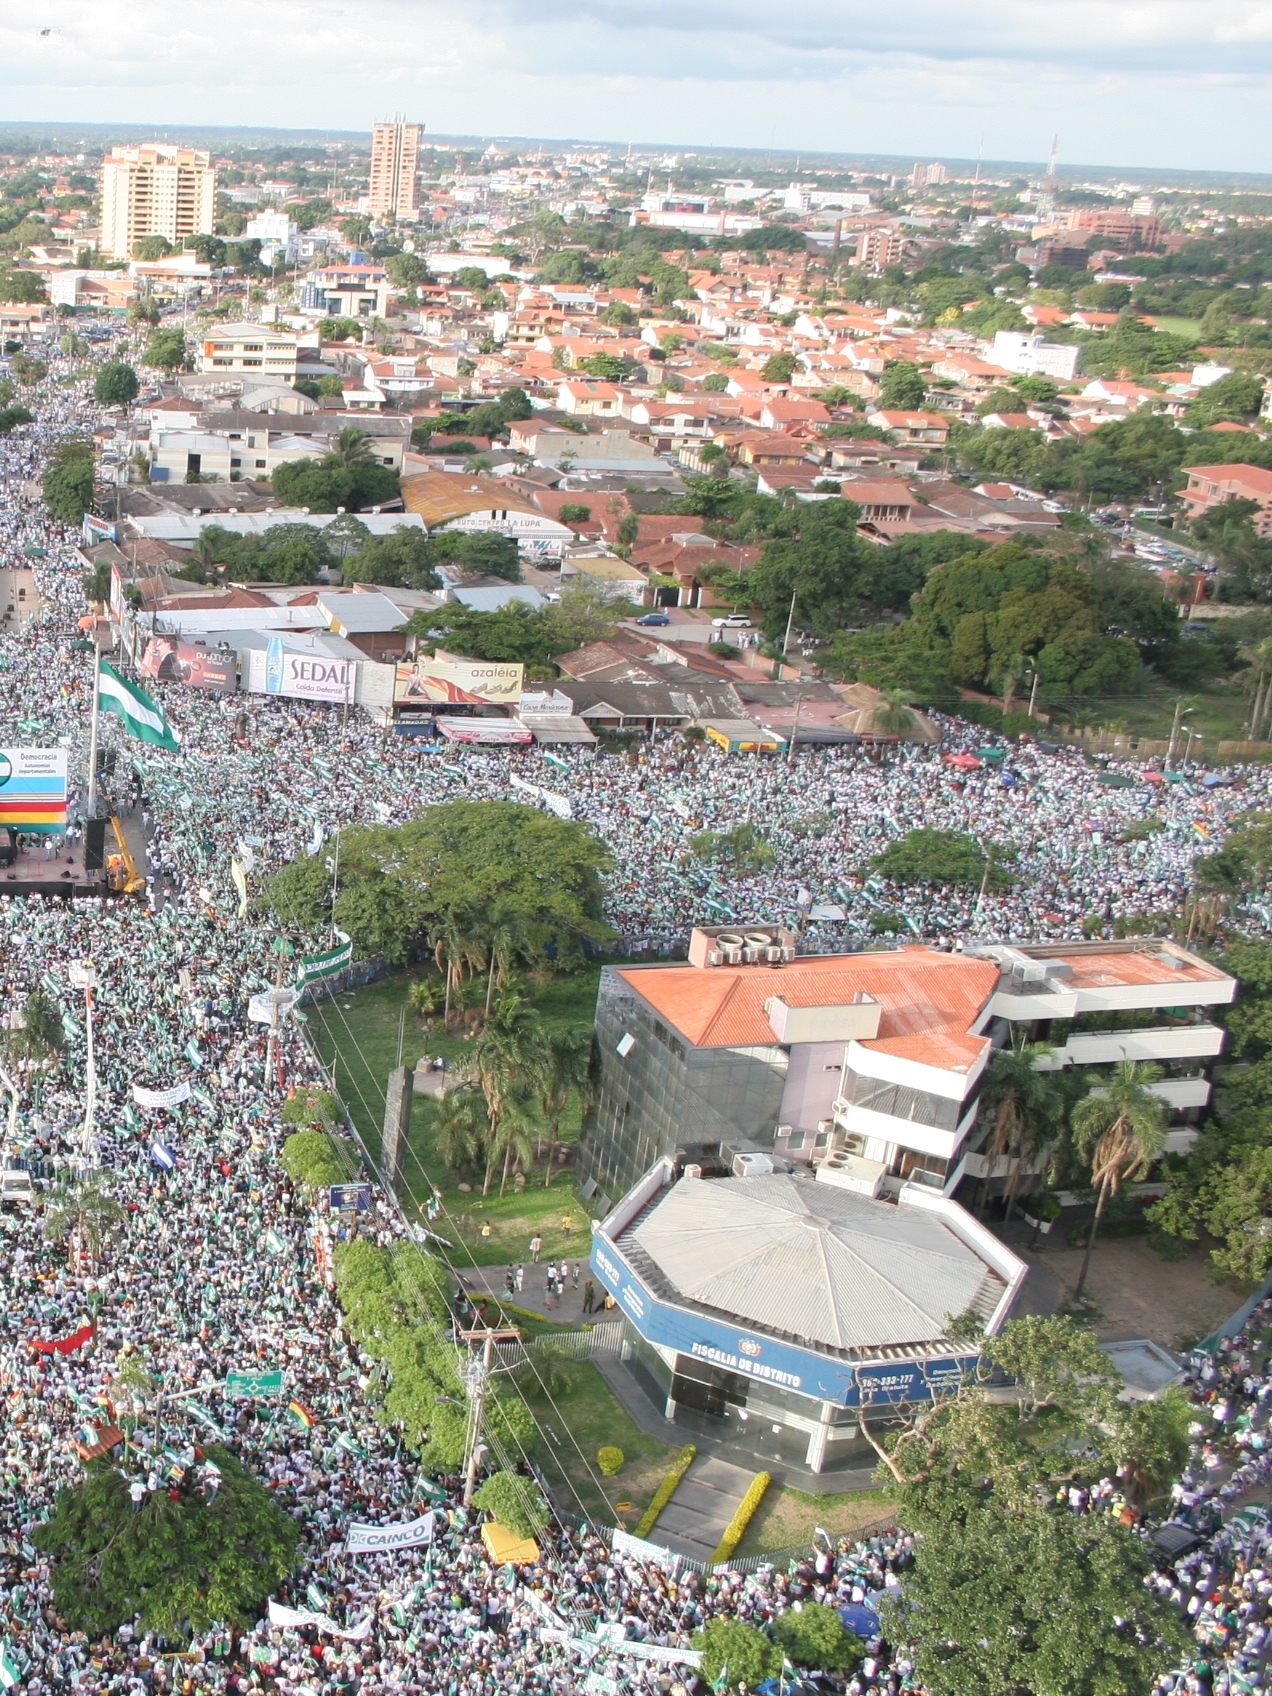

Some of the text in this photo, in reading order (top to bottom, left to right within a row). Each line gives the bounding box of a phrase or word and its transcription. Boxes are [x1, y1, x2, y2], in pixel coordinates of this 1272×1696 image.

[290, 658, 351, 685] SEDAL
[471, 666, 518, 678] azaléia
[20, 753, 58, 761] Democracia
[691, 1343, 801, 1388] FISCALIA DE DISTRITO
[366, 1524, 426, 1545] CAINCO
